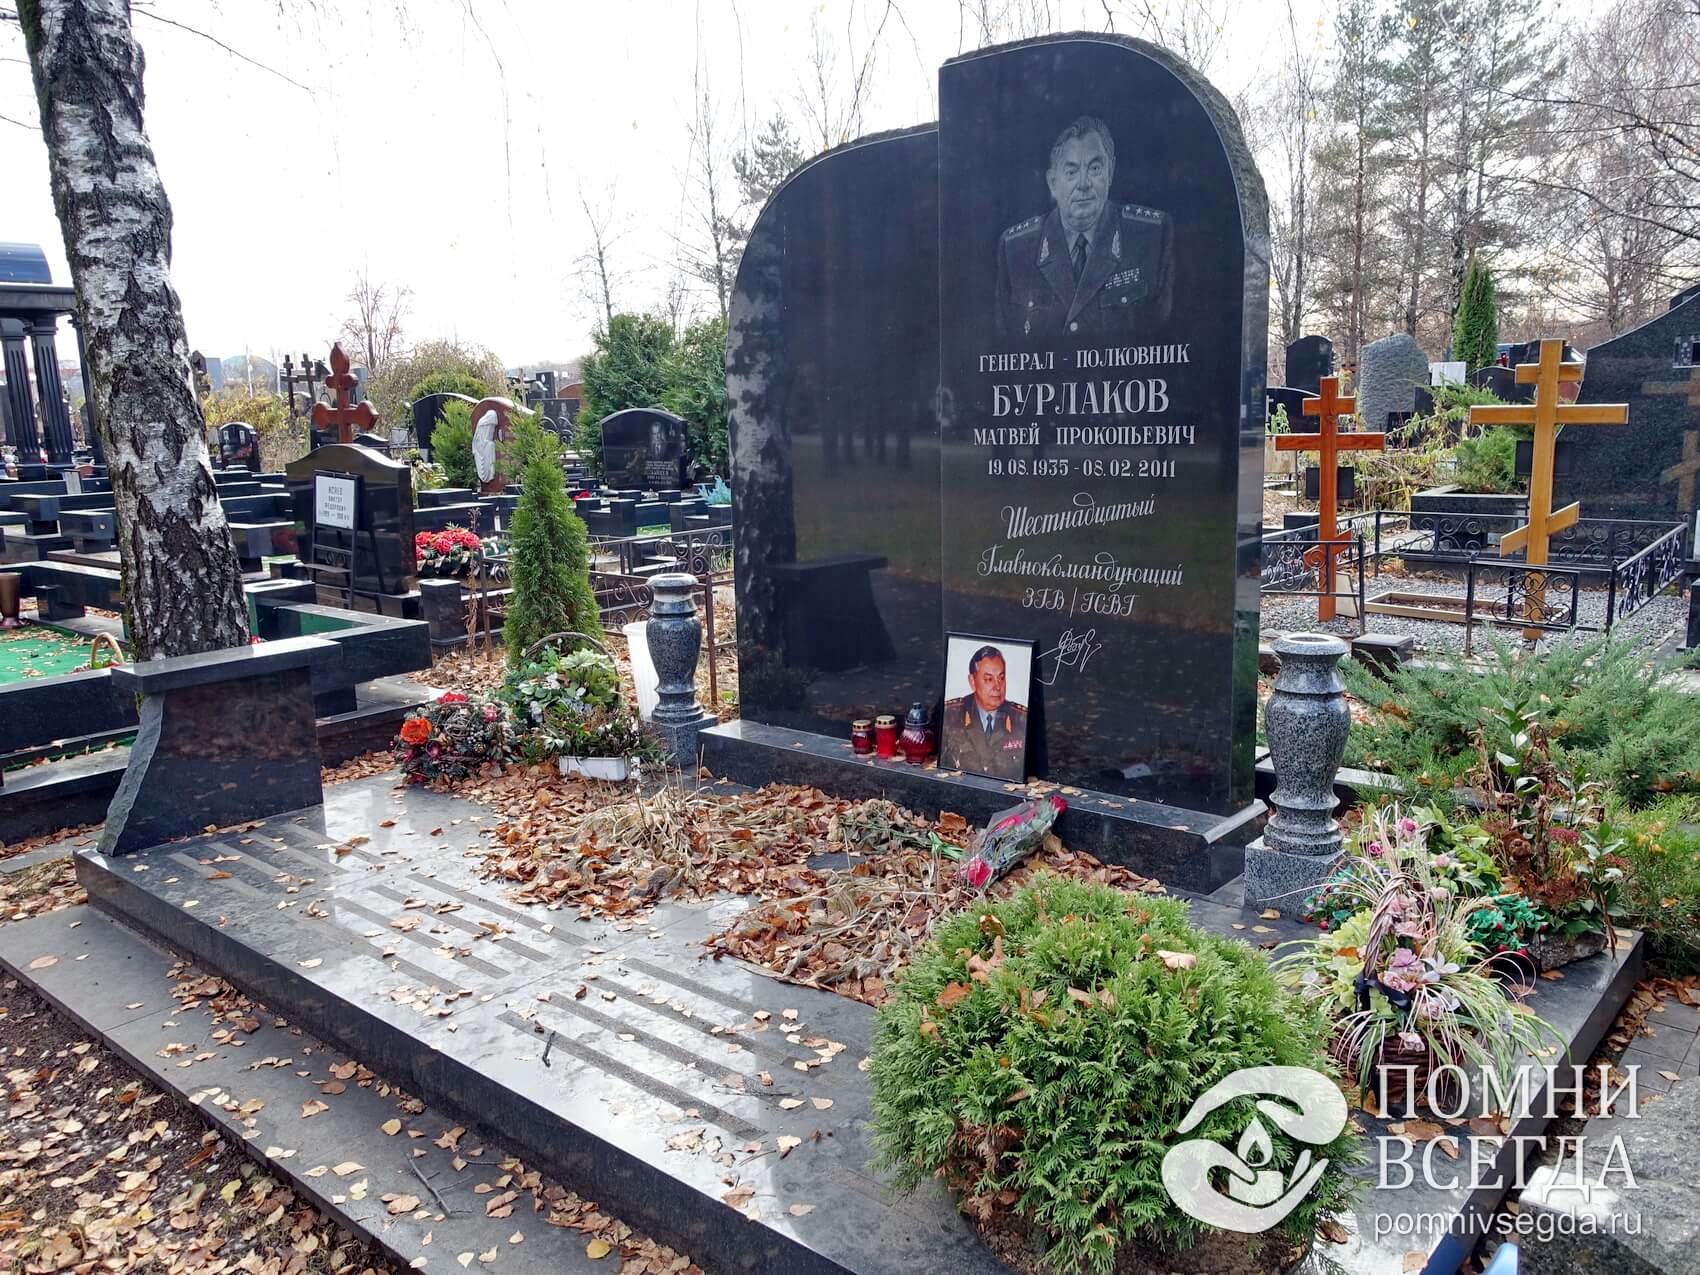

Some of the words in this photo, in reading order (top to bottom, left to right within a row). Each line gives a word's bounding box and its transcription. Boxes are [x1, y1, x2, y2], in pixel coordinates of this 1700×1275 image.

[979, 352, 1055, 372] ГЕНЕРАЛ
[1076, 344, 1190, 368] ПОЛКОВНИК
[992, 378, 1169, 417] БУРЛАКОВ
[973, 422, 1040, 446] МАТВЕЙ
[1056, 425, 1196, 445] ПРОКОПЬЕВИЧ
[1001, 492, 1156, 540] Шестнадцатый
[977, 544, 1184, 593] Главнокомандующий
